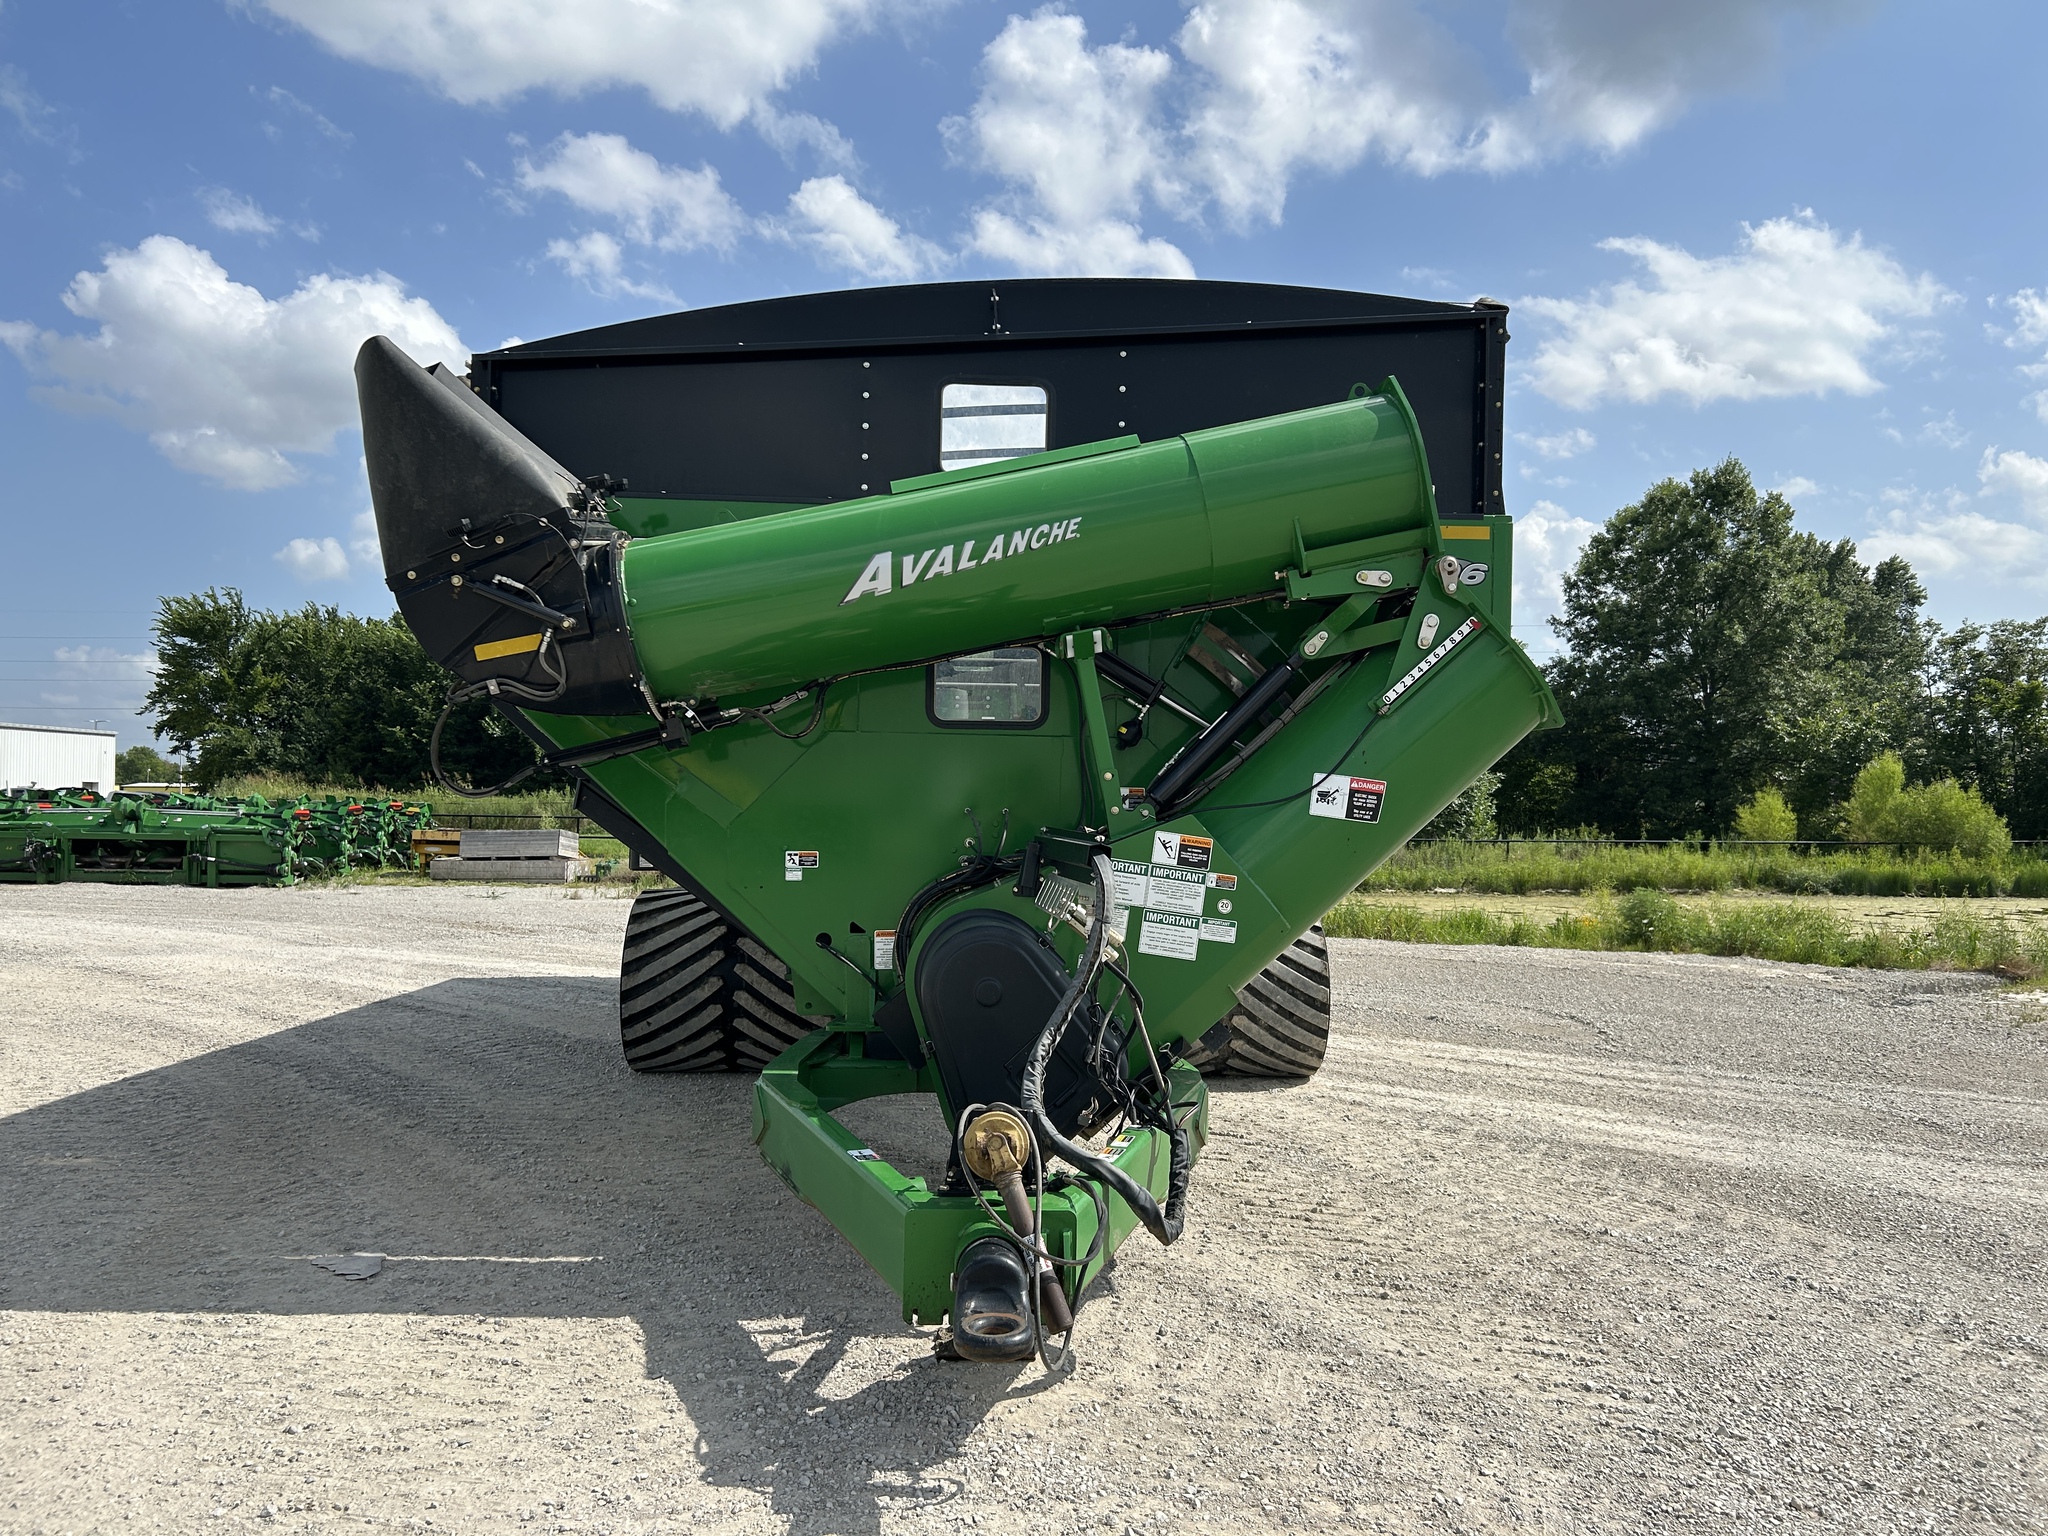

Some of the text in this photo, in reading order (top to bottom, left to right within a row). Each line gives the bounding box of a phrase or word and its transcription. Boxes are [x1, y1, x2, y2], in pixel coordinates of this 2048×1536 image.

[1457, 561, 1489, 586] 6
[1441, 644, 1448, 652] 7
[1358, 782, 1384, 791] DANGER
[1186, 838, 1211, 847] WARNING
[1112, 861, 1147, 874] ORTANT
[1153, 868, 1204, 883] IMPORTANT
[1146, 912, 1197, 927] IMPORTANT
